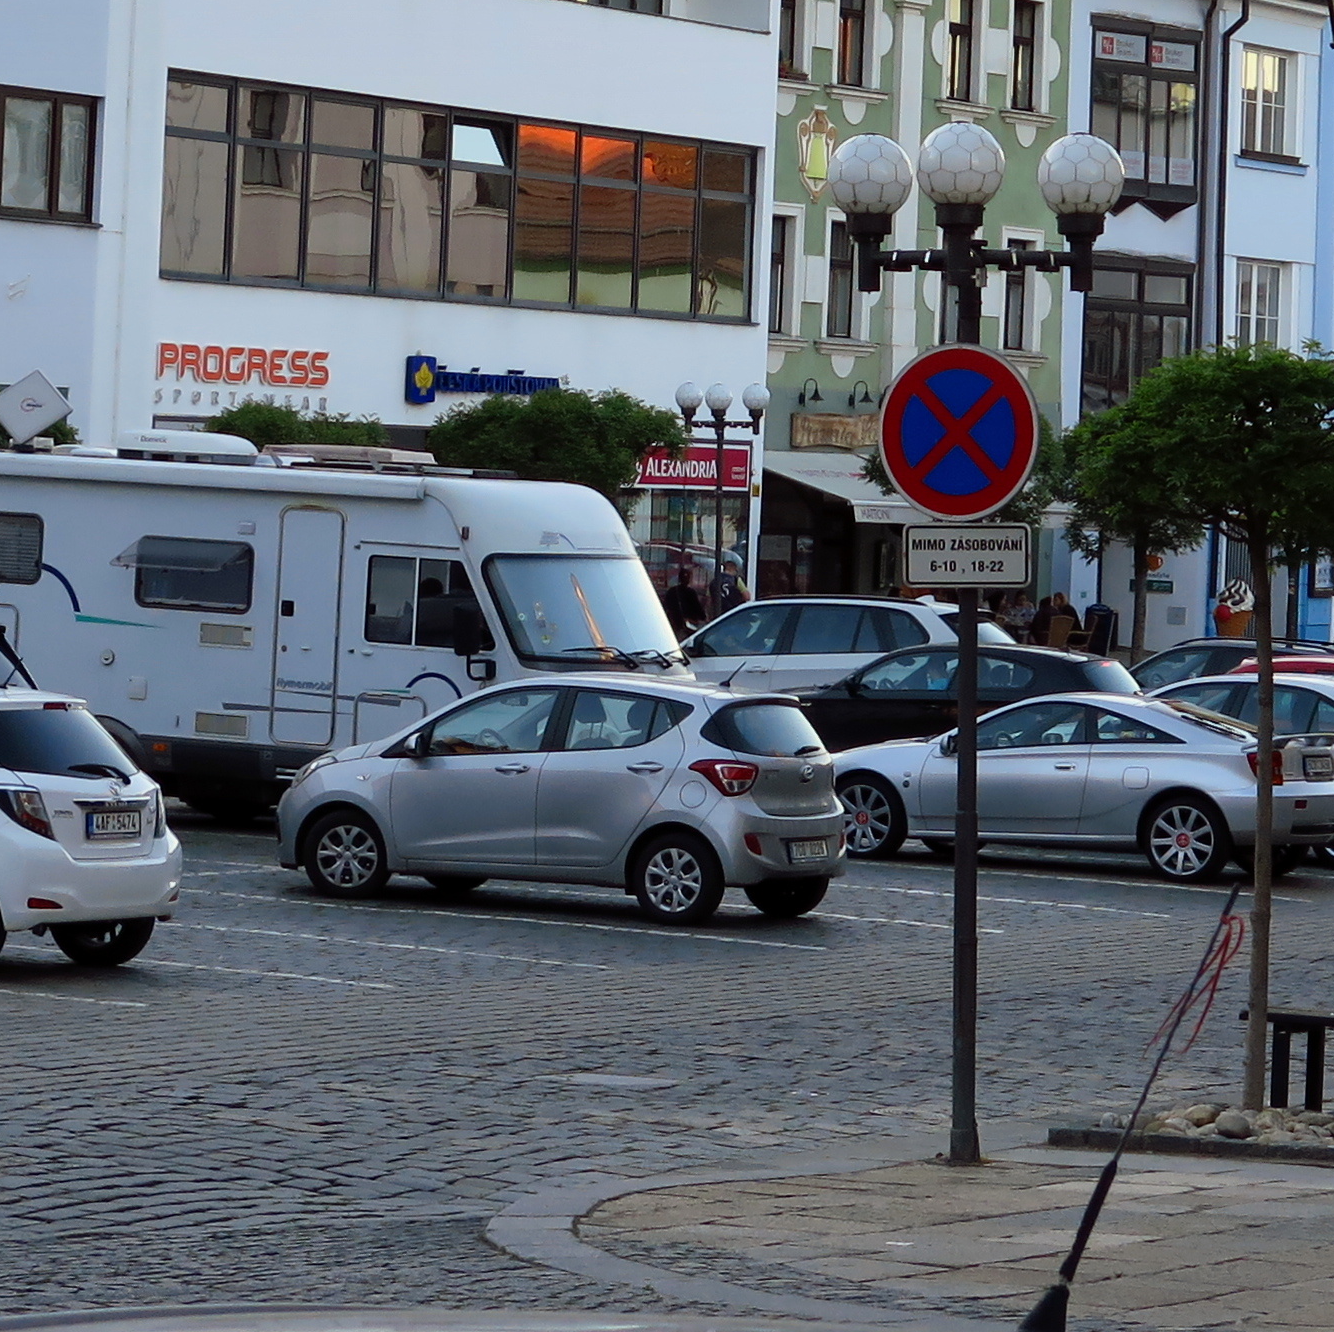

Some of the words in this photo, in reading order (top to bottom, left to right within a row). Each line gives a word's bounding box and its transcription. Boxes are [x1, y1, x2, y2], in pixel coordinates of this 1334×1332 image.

[156, 341, 331, 388] PROGRESS
[645, 456, 718, 480] ALEXANDRIA
[911, 539, 946, 551] MIMO
[949, 535, 1023, 552] ZÁSOBOVÁNÍ
[930, 560, 957, 572] 6-10
[970, 560, 1004, 573] 18-22
[95, 814, 110, 831] 4AF
[116, 814, 136, 831] 5474
